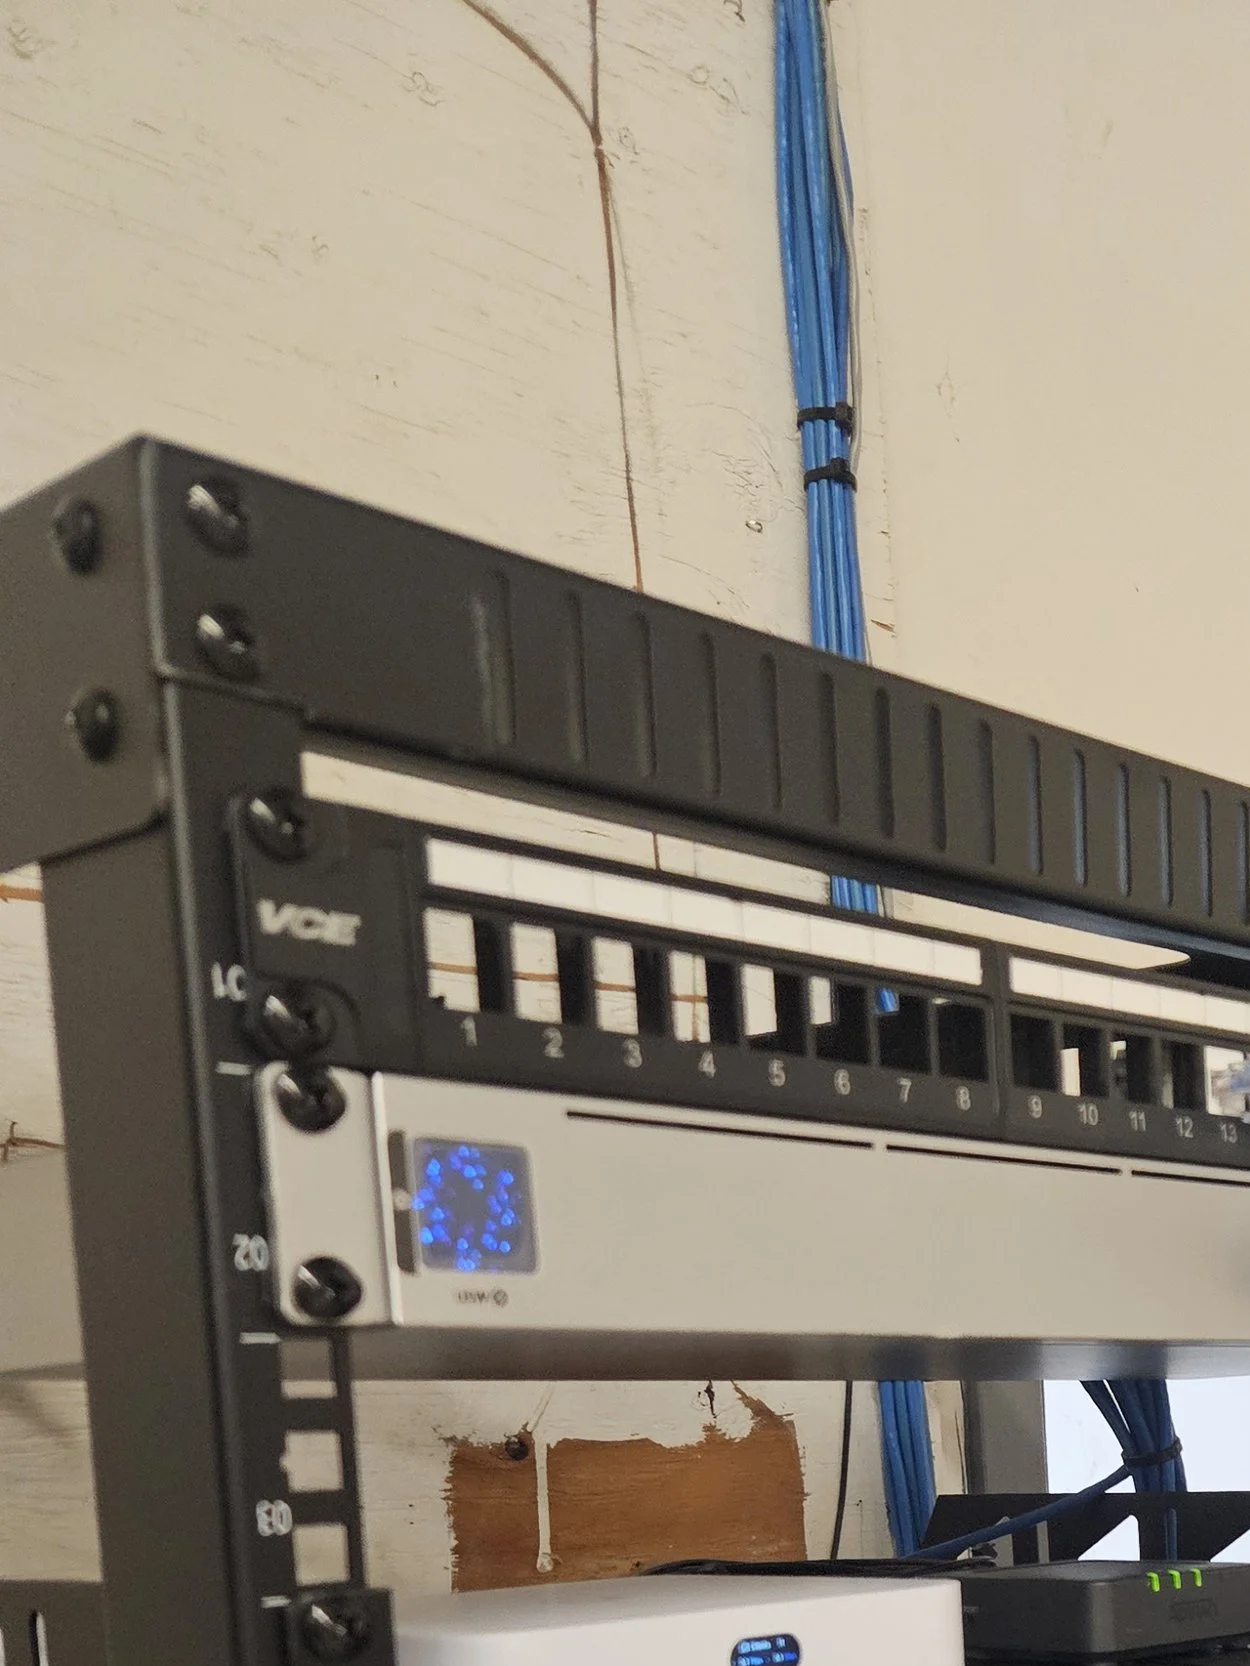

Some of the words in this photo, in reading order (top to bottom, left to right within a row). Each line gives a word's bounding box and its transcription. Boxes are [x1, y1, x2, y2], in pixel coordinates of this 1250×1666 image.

[256, 898, 362, 947] VCE
[460, 1015, 478, 1048] 1
[541, 1026, 565, 1059] 2
[622, 1038, 643, 1069] 3
[698, 1051, 716, 1079] 4
[769, 1059, 787, 1087] 5
[834, 1068, 851, 1096] 6
[897, 1077, 913, 1104] 7
[956, 1085, 972, 1112] 8
[1028, 1095, 1043, 1120] 9
[1076, 1102, 1099, 1126] 10
[1128, 1110, 1147, 1133] 11
[1175, 1115, 1194, 1138] 12
[1220, 1121, 1238, 1144] 13
